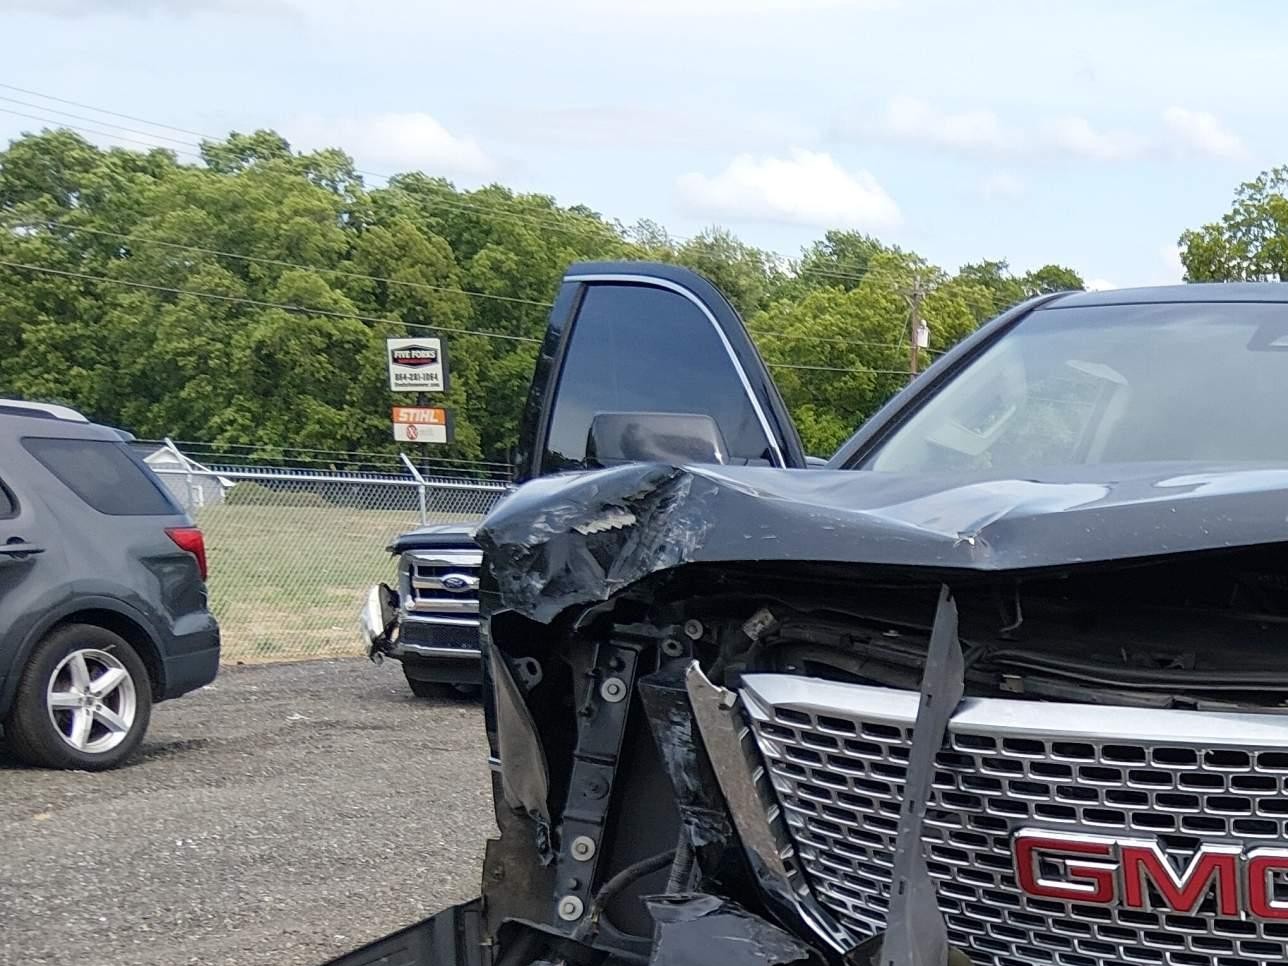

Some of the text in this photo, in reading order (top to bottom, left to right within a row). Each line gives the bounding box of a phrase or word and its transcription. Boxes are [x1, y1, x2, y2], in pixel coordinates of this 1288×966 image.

[394, 350, 436, 359] FIVE FORKS
[398, 408, 439, 423] STIHL
